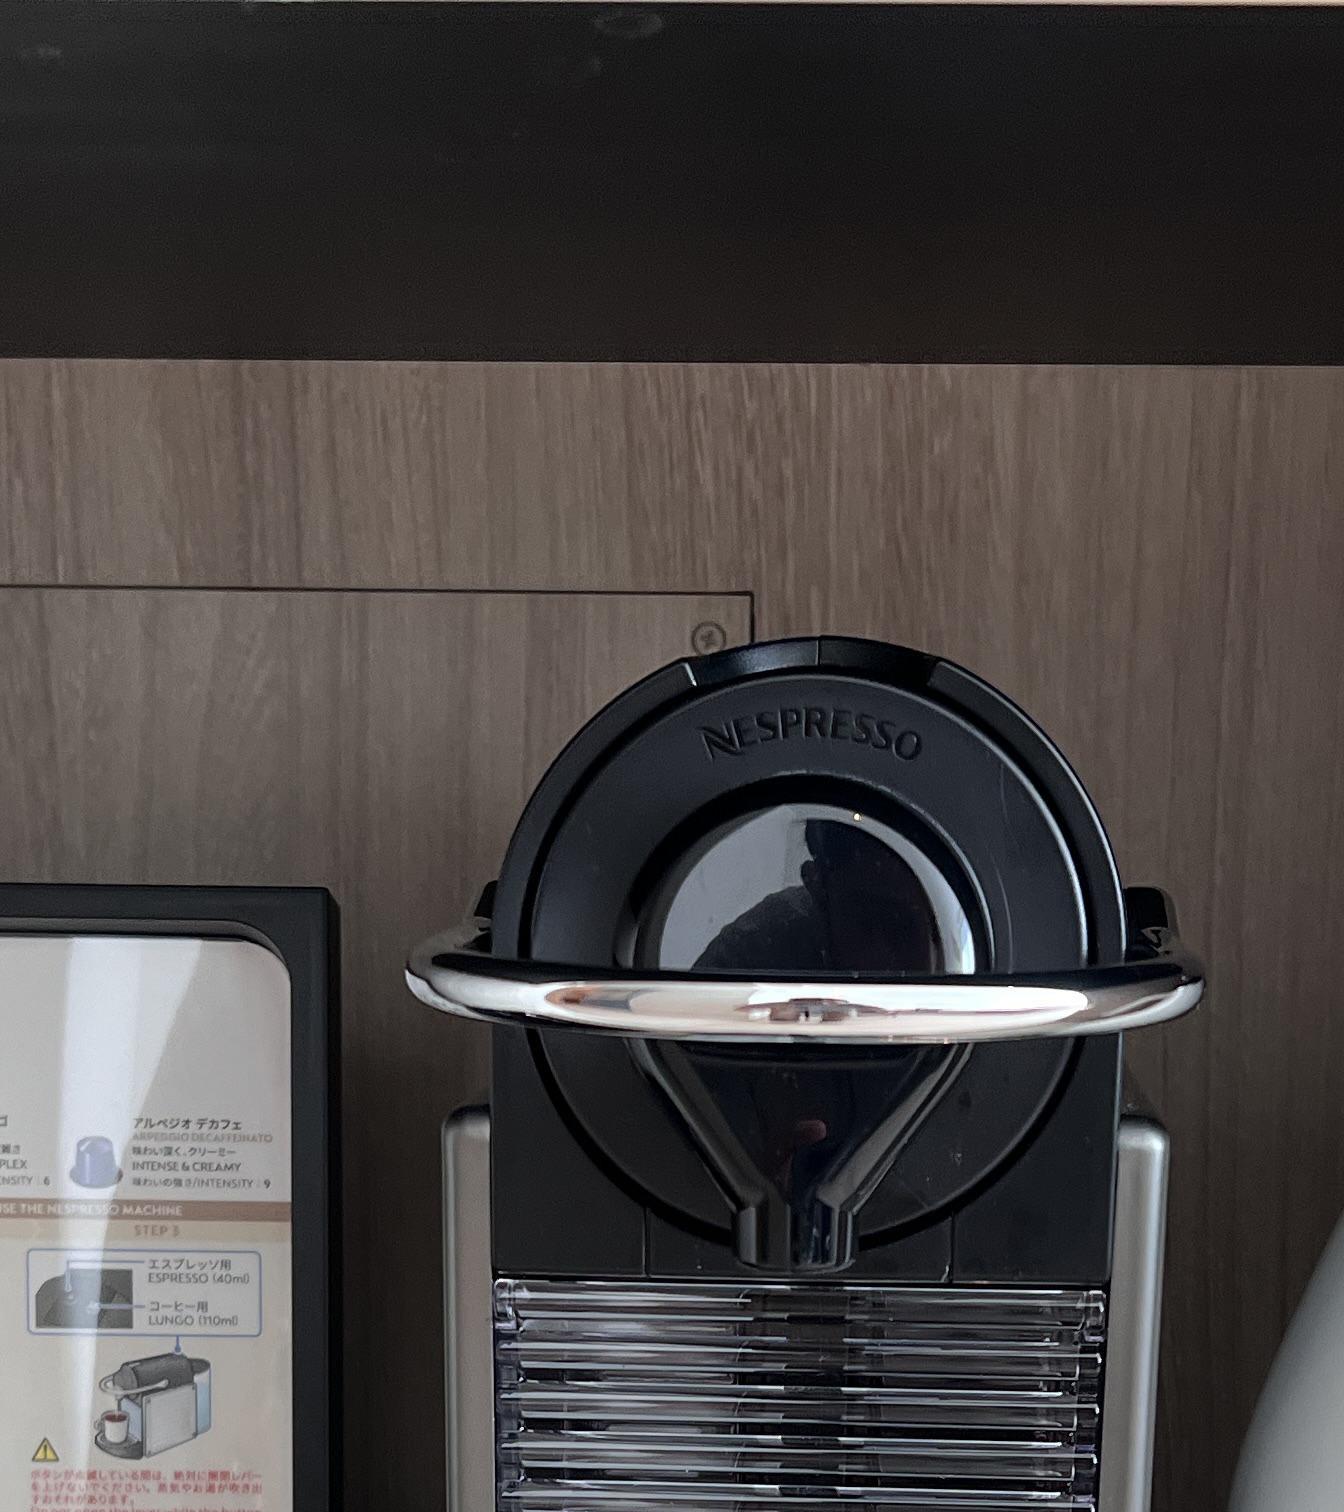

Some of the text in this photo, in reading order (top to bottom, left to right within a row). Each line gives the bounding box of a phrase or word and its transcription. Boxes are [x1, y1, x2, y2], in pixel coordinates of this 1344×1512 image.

[696, 706, 923, 762] NESPRESSO
[134, 1117, 242, 1131] アルペジオ デカフェ
[132, 1161, 179, 1171] INTENSE
[192, 1162, 242, 1172] CREAMY
[20, 1203, 44, 1215] THE
[122, 1205, 183, 1216] MACHINE
[134, 1225, 168, 1236] STEP
[149, 1259, 231, 1271] エスプレッソ用
[148, 1273, 209, 1284] ESPRESSO
[149, 1301, 208, 1313] コーヒー用
[148, 1315, 195, 1326] LUNGO
